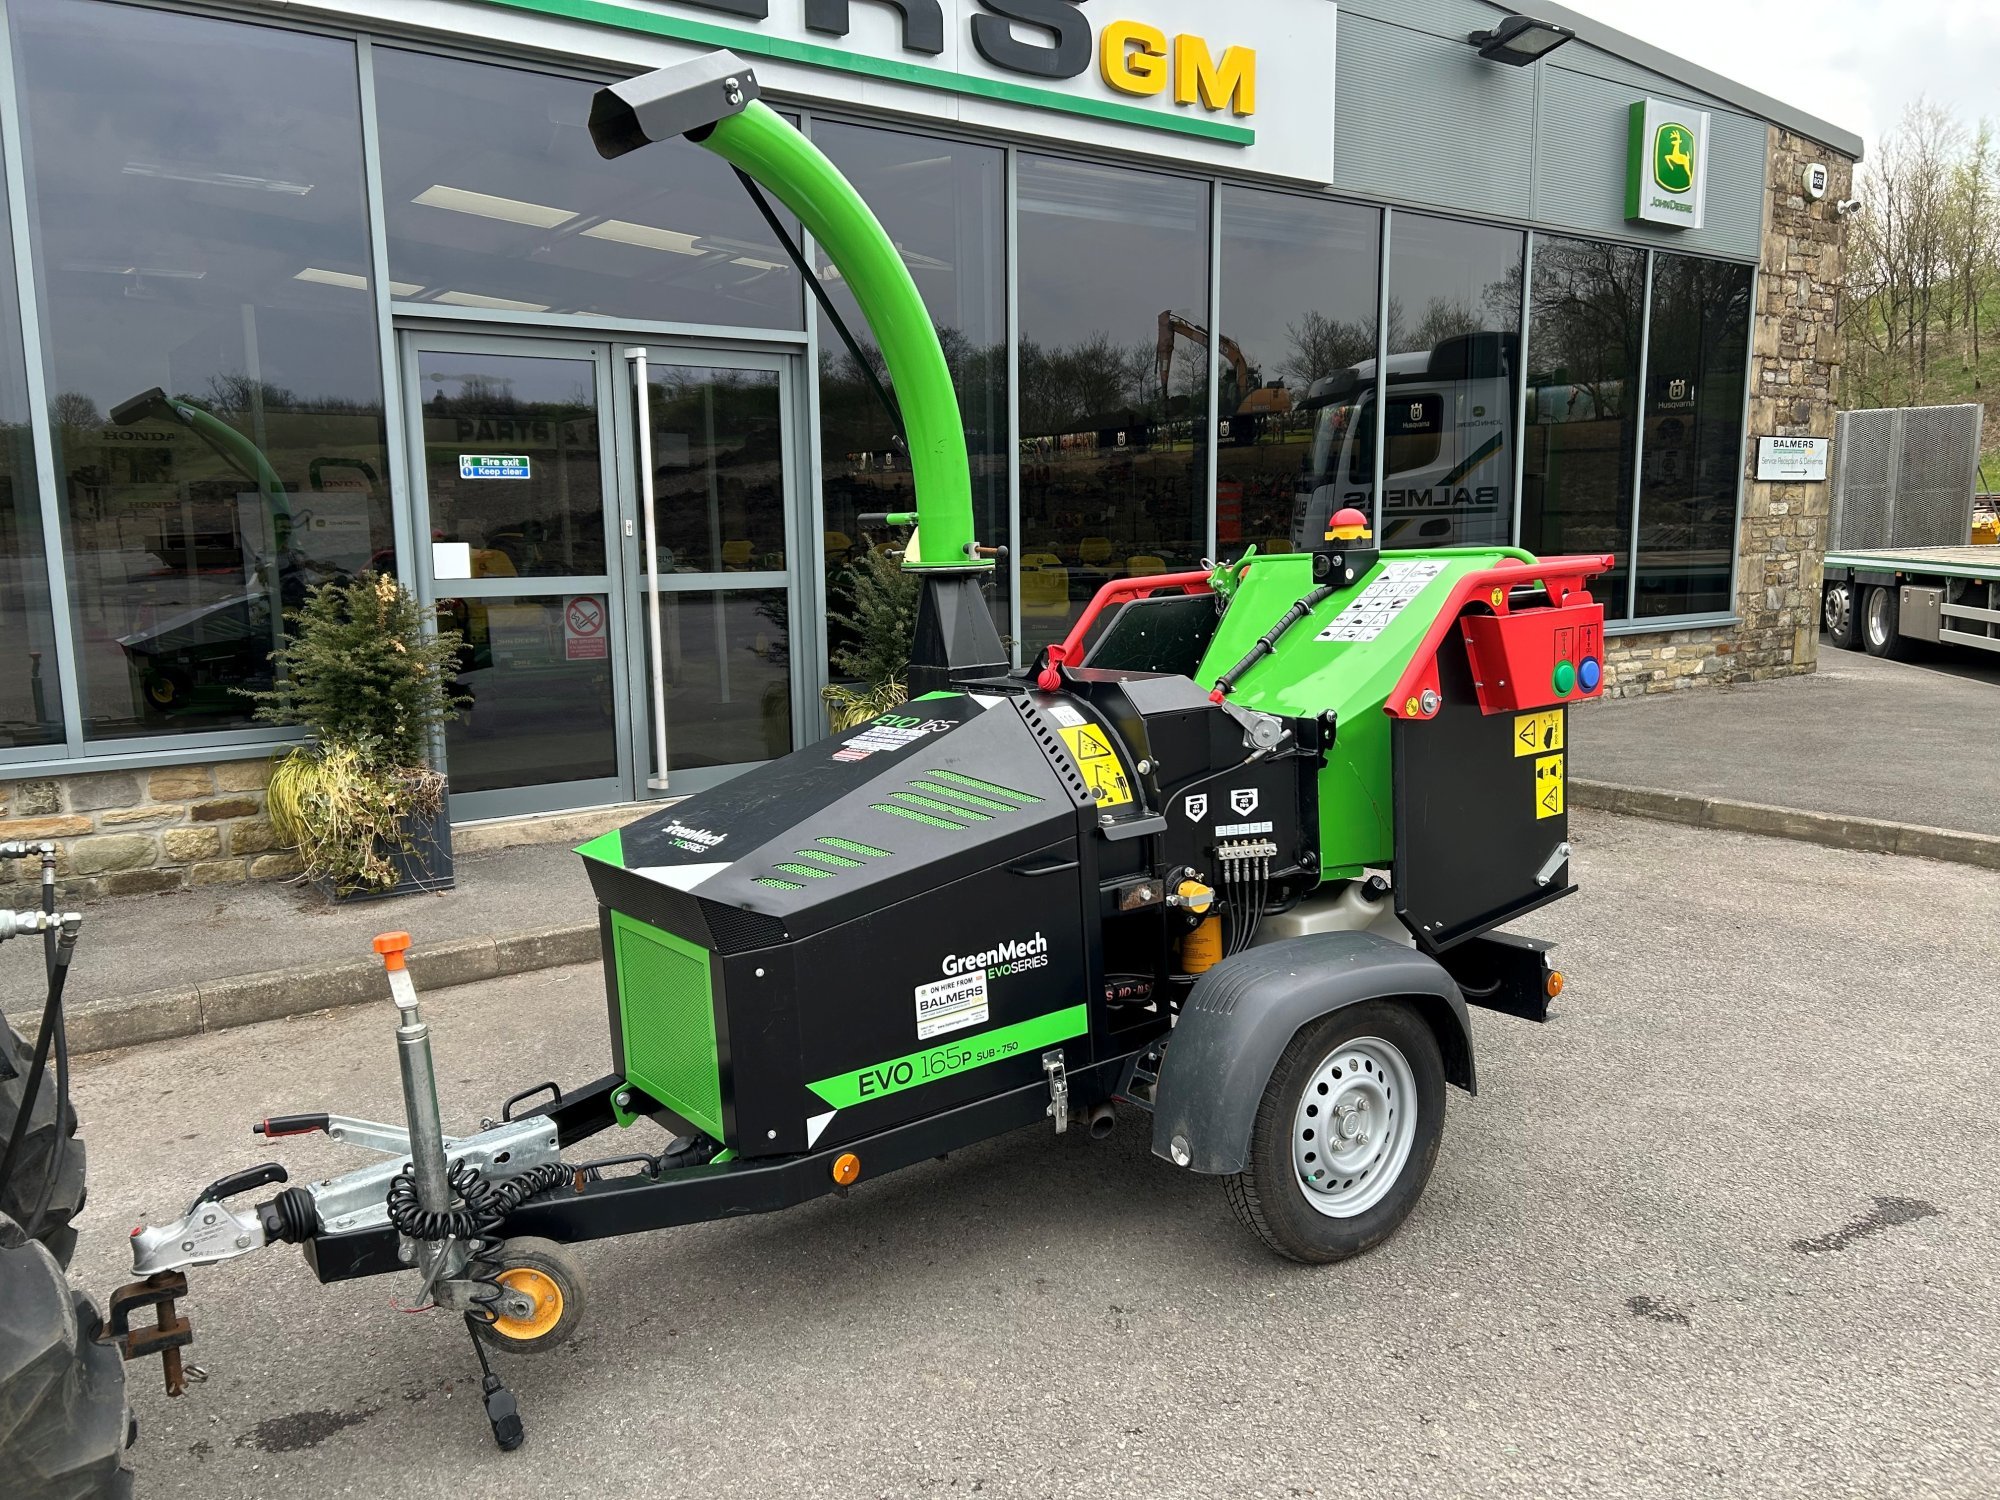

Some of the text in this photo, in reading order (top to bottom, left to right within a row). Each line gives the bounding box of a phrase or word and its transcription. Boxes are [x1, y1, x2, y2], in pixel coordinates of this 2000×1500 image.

[1100, 20, 1257, 116] GM
[1773, 440, 1814, 448] BALMERS
[480, 457, 520, 467] Fire exit
[1761, 457, 1777, 465] Service
[478, 467, 523, 477] Keep clear
[871, 714, 921, 728] EVO
[942, 932, 1047, 976] GreenMech
[987, 954, 1048, 980] EVOSERIES
[930, 977, 973, 994] ON HIRE FROM
[920, 985, 983, 1011] BALMERS
[858, 1061, 913, 1096] EVO
